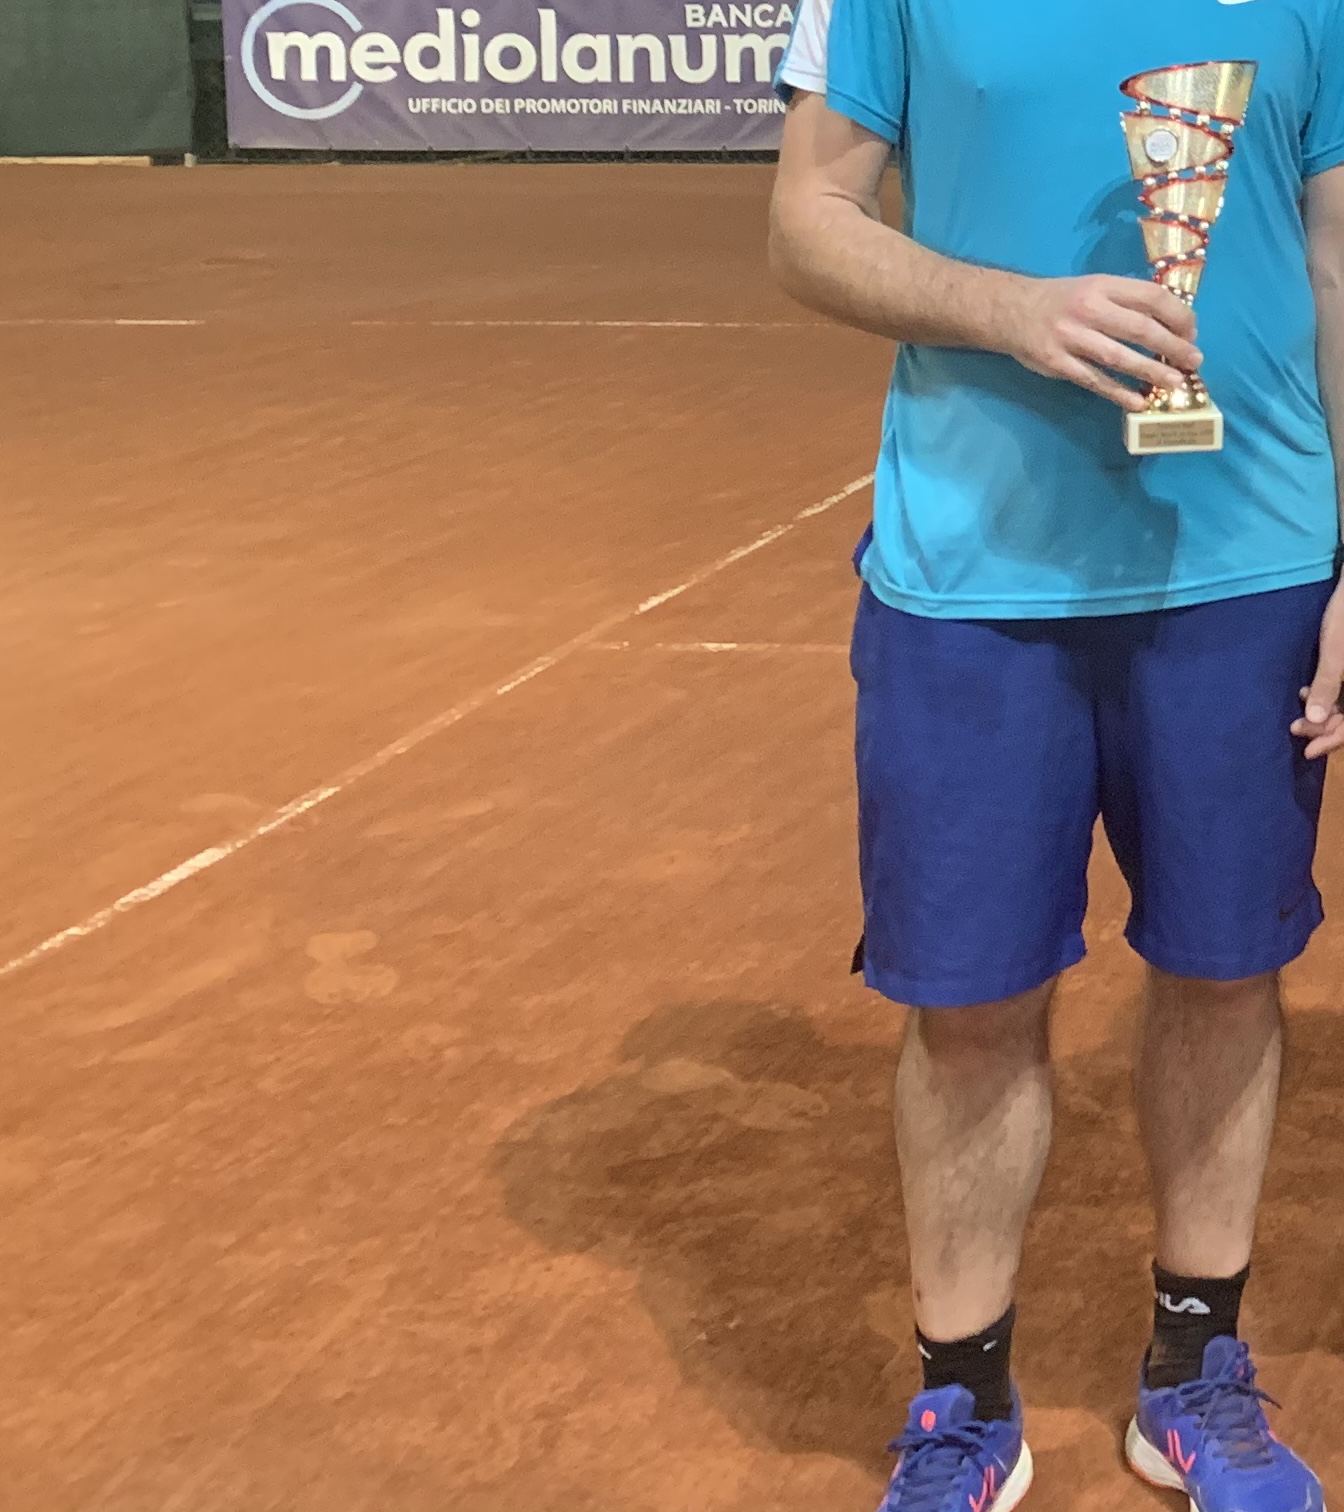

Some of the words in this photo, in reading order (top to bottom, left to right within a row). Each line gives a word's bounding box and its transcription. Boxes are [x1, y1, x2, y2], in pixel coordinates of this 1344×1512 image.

[686, 4, 794, 27] BANCA
[267, 9, 790, 84] mediolanum
[408, 97, 477, 114] UFFICIO
[480, 98, 511, 114] DEI
[514, 98, 617, 114] PROMOTORI
[622, 98, 721, 114] FINANZIARI
